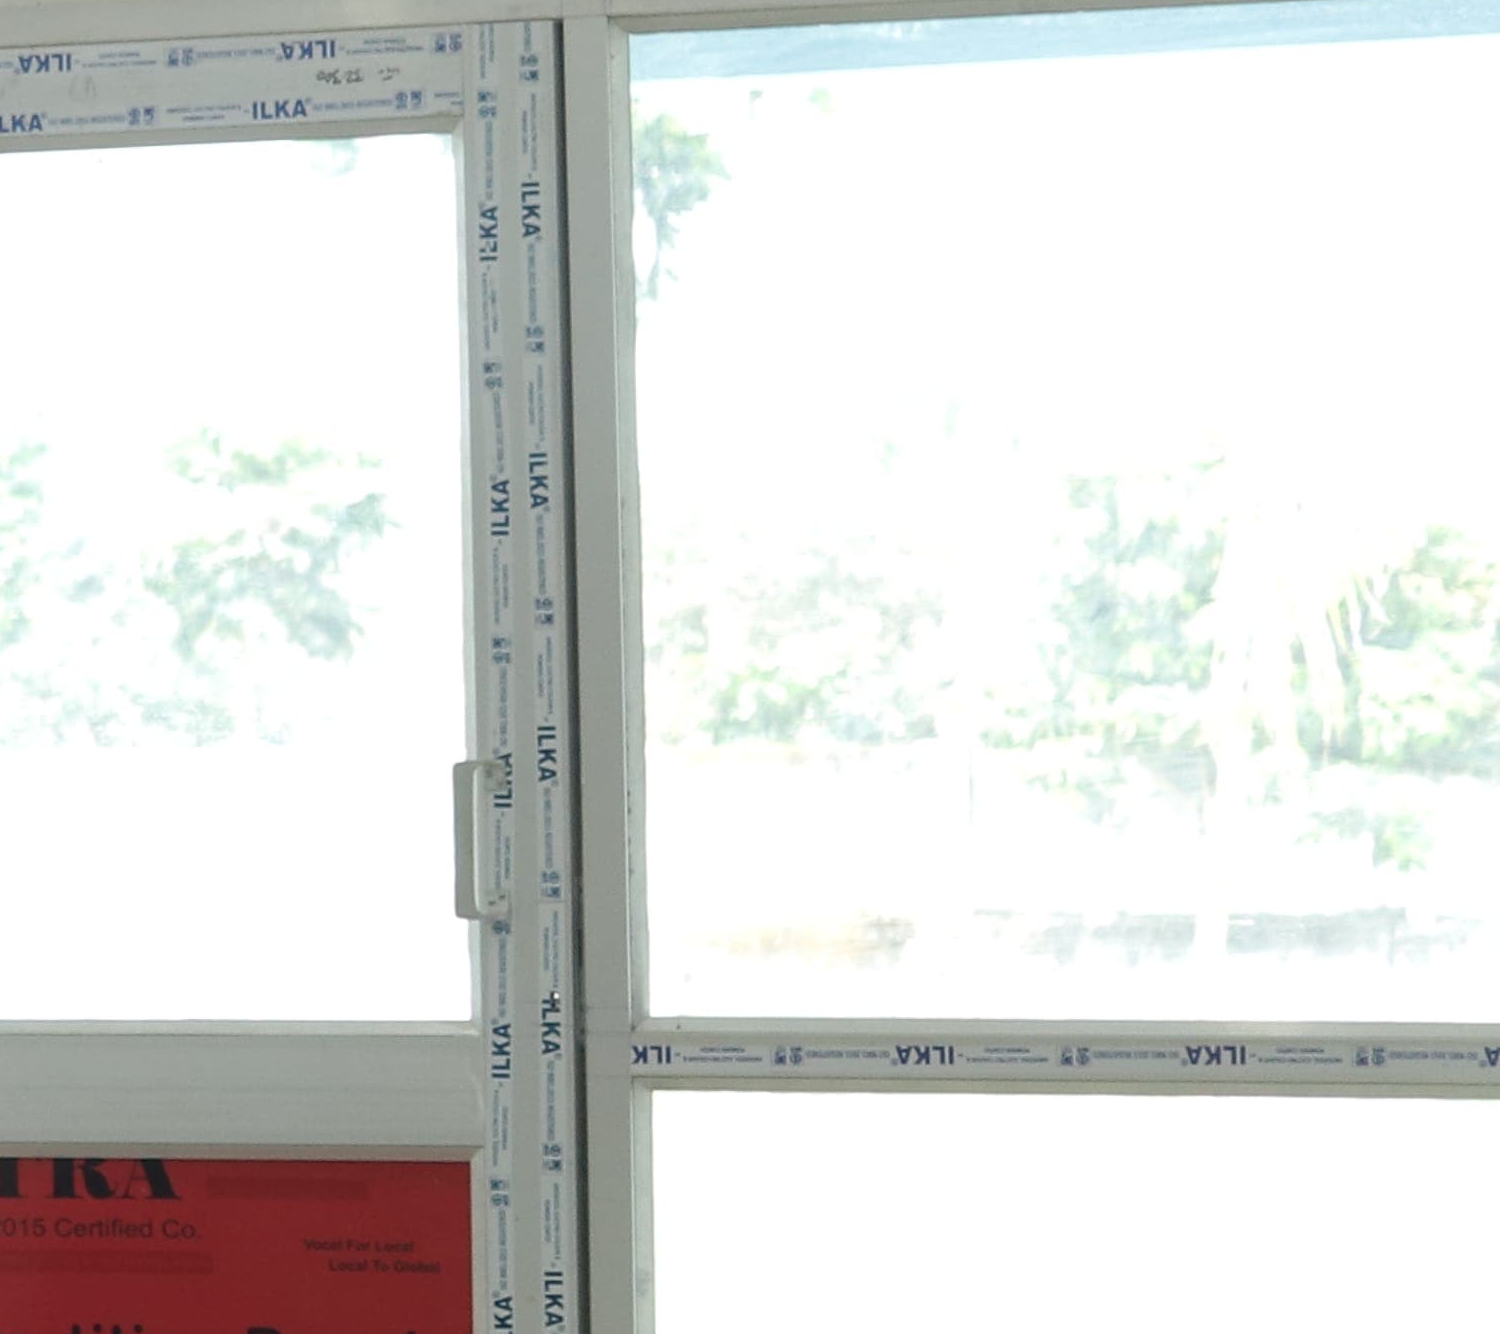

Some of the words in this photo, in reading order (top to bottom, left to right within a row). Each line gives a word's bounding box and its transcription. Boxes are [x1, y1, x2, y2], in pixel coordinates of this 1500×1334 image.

[18, 54, 71, 73] ILKA
[281, 39, 336, 59] ILKA
[253, 99, 307, 119] ILKA
[521, 182, 540, 237] ILKA
[529, 453, 548, 508] ILKA
[491, 480, 509, 536] ILKA
[538, 726, 556, 781] ILKA
[492, 1024, 510, 1078] ILKA
[896, 1046, 954, 1064] ILKA
[1186, 1046, 1245, 1065] ILKA
[54, 1218, 153, 1239] Certified
[544, 1272, 564, 1326] ILKA
